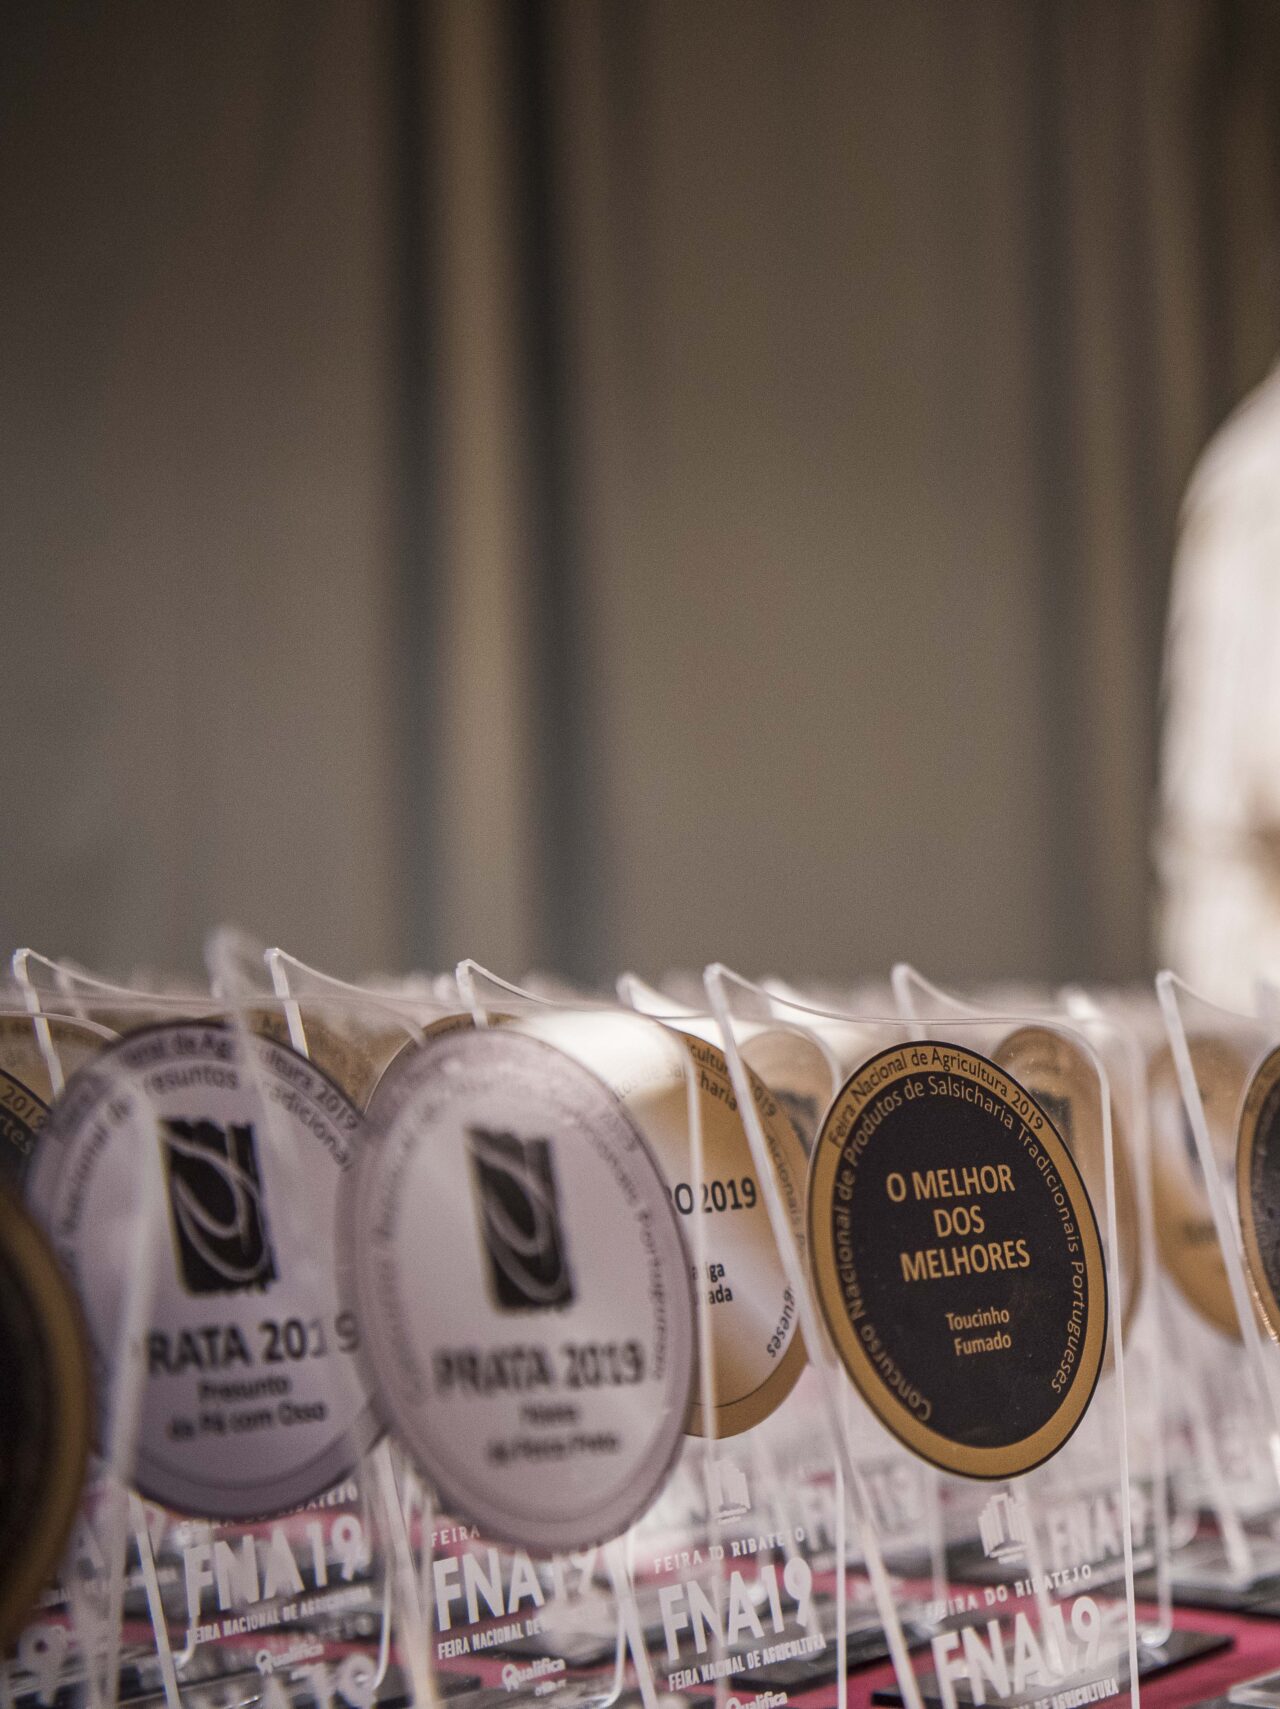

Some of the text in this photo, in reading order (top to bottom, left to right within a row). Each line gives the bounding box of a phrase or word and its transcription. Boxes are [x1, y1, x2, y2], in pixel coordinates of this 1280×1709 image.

[144, 1066, 242, 1095] esuntos
[828, 1048, 1045, 1149] Feira Nacional de Agricultura 2019
[886, 1163, 1015, 1202] O MELHOR
[933, 1205, 985, 1238] DOS
[834, 1074, 1085, 1422] Concurso Nacional de Produtos de Salsicharia Tradicionais Portugueses
[900, 1239, 1031, 1283] MELHORES
[945, 1306, 1010, 1332] Toucinho
[146, 1319, 252, 1376] RATA
[954, 1331, 1012, 1357] Fumado
[433, 1339, 645, 1396] PRATA 2019
[431, 1525, 480, 1547] FEIRA
[654, 1550, 703, 1574] FEIRA
[731, 1527, 805, 1558] RIBATEO
[658, 1557, 812, 1662] FNA19
[984, 1585, 1008, 1606] DO
[438, 1637, 471, 1660] FEIRA
[931, 1595, 1101, 1709] FNA19
[668, 1667, 700, 1692] FEIRA
